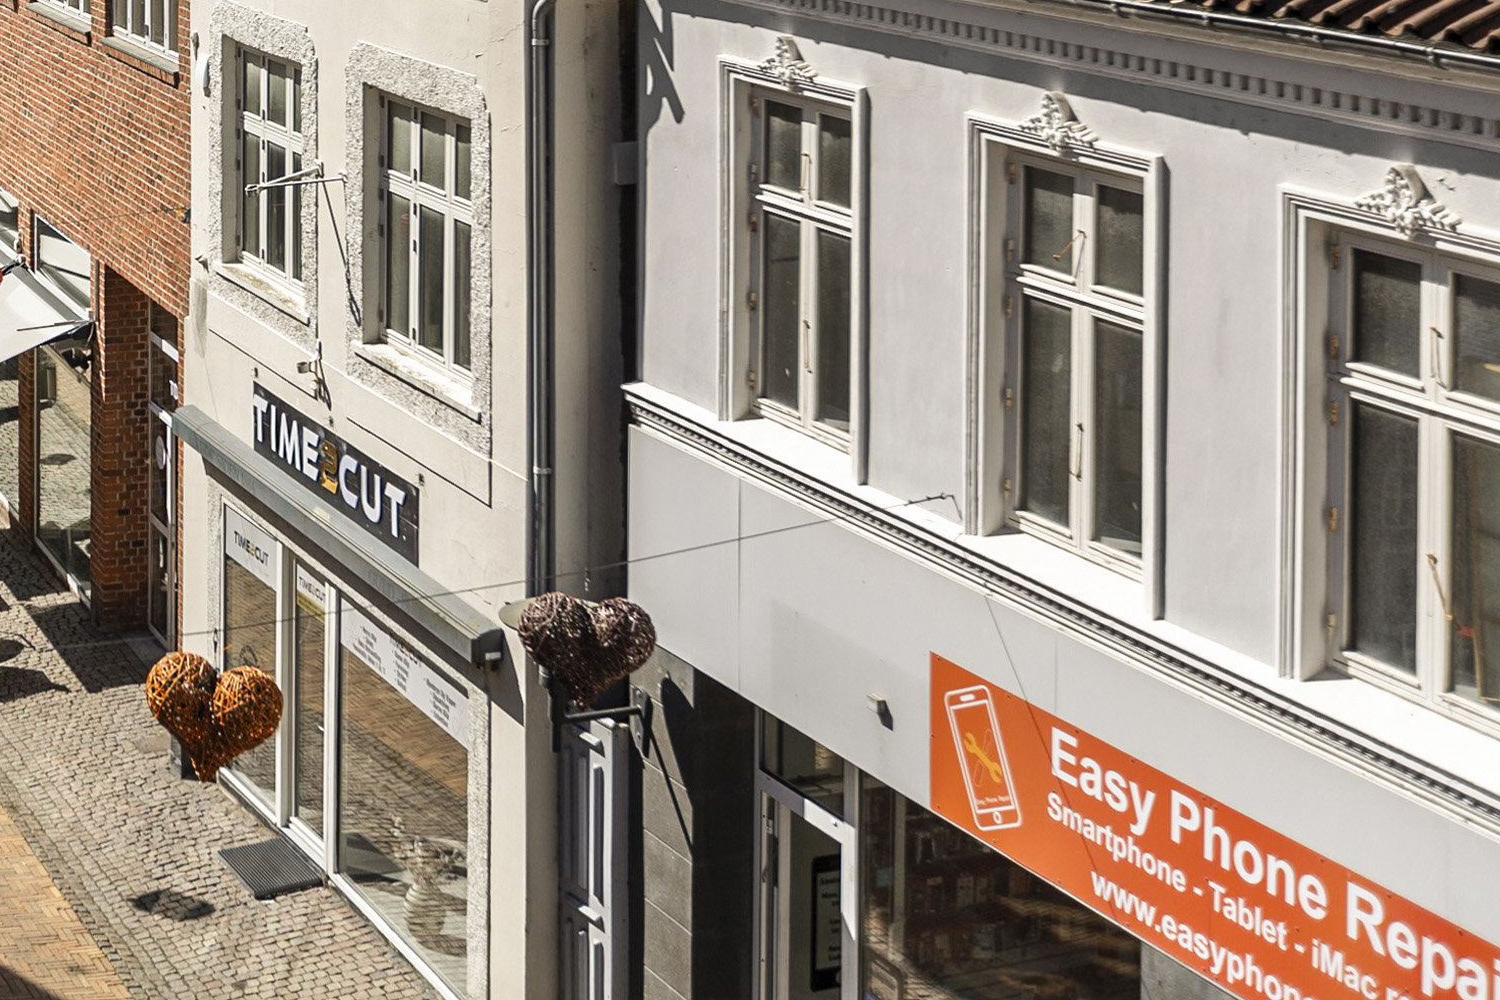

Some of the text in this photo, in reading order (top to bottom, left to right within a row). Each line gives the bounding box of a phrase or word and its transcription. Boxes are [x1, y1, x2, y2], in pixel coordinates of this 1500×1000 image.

[252, 393, 406, 538] TIME2CUT
[1047, 790, 1186, 892] Smartphone
[1207, 879, 1288, 951] Tablet
[1311, 938, 1380, 1000] iMac
[1051, 726, 1156, 837] Easy
[1170, 788, 1329, 921] Phone
[1090, 870, 1314, 1000] www.easyphon
